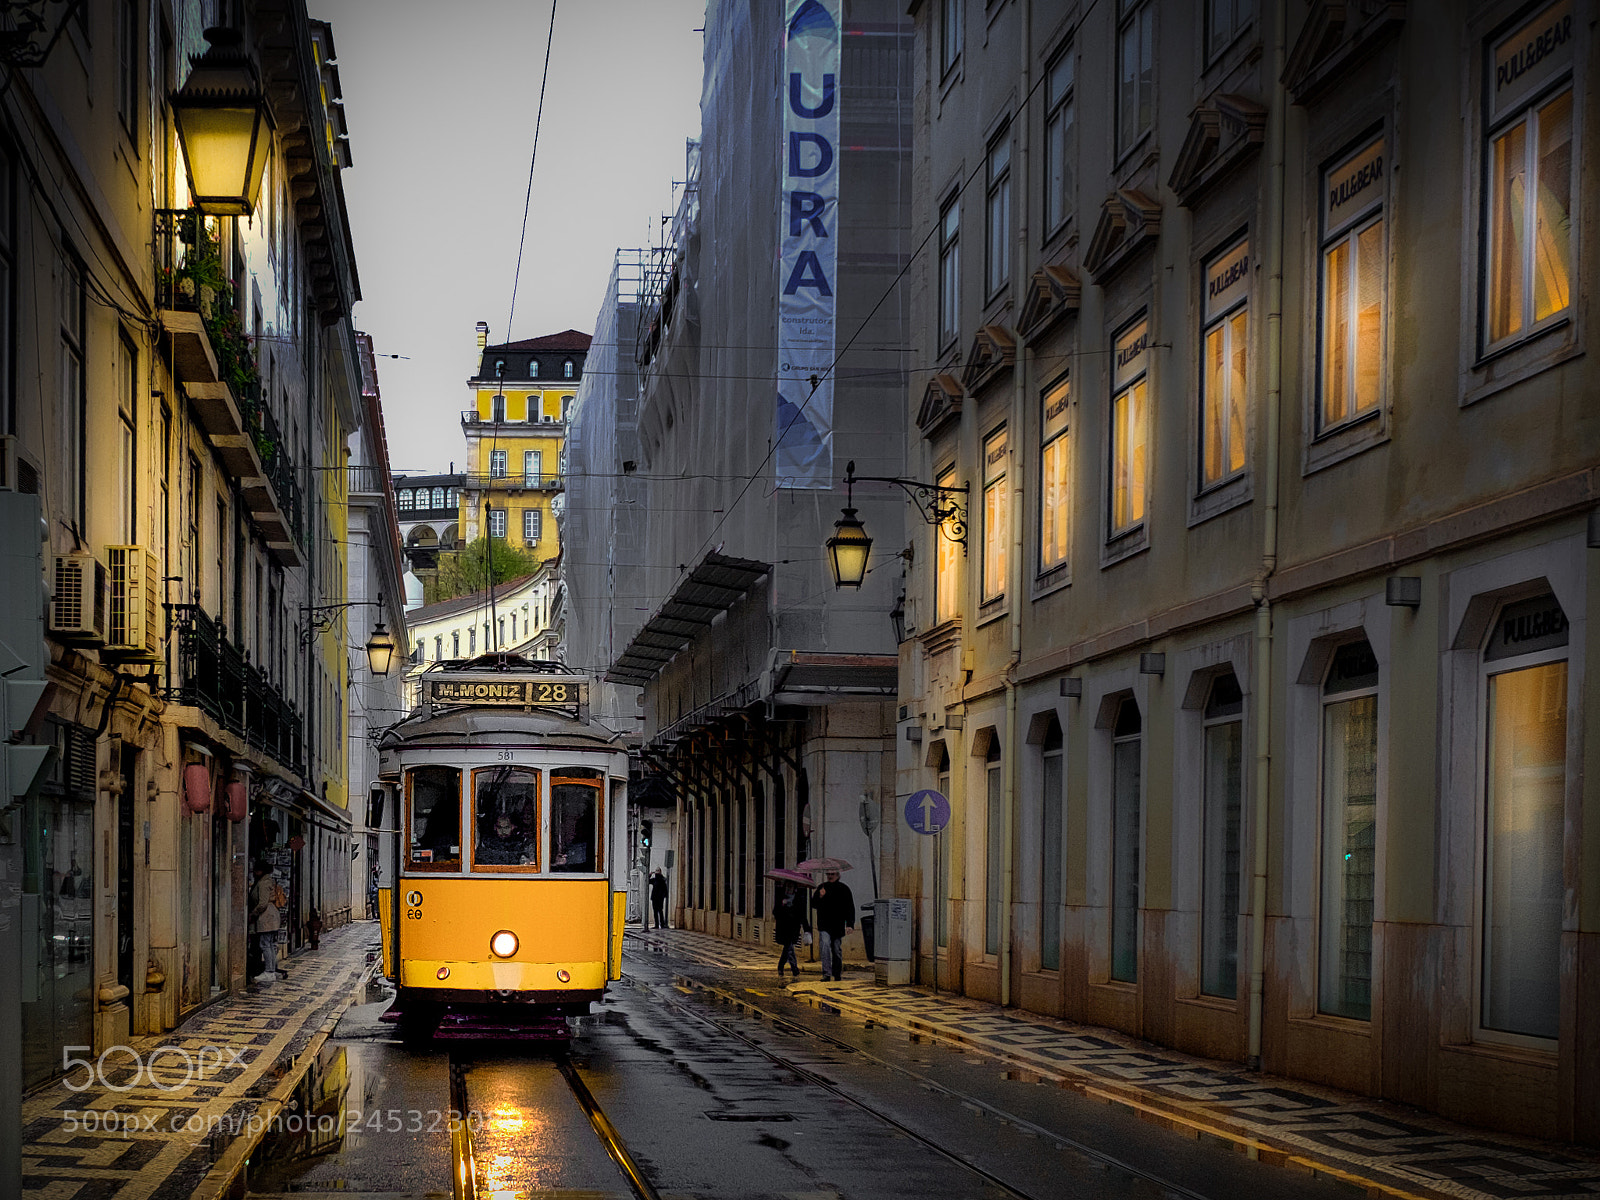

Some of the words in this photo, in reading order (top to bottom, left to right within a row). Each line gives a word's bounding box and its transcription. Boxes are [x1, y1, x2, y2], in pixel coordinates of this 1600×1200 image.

[1497, 14, 1571, 92] PULL&BEAR
[783, 73, 835, 297] UDRA
[1330, 156, 1383, 212] PULL&BEAR
[438, 683, 522, 698] M.MONIZ
[538, 683, 568, 702] 28
[497, 751, 515, 761] 581
